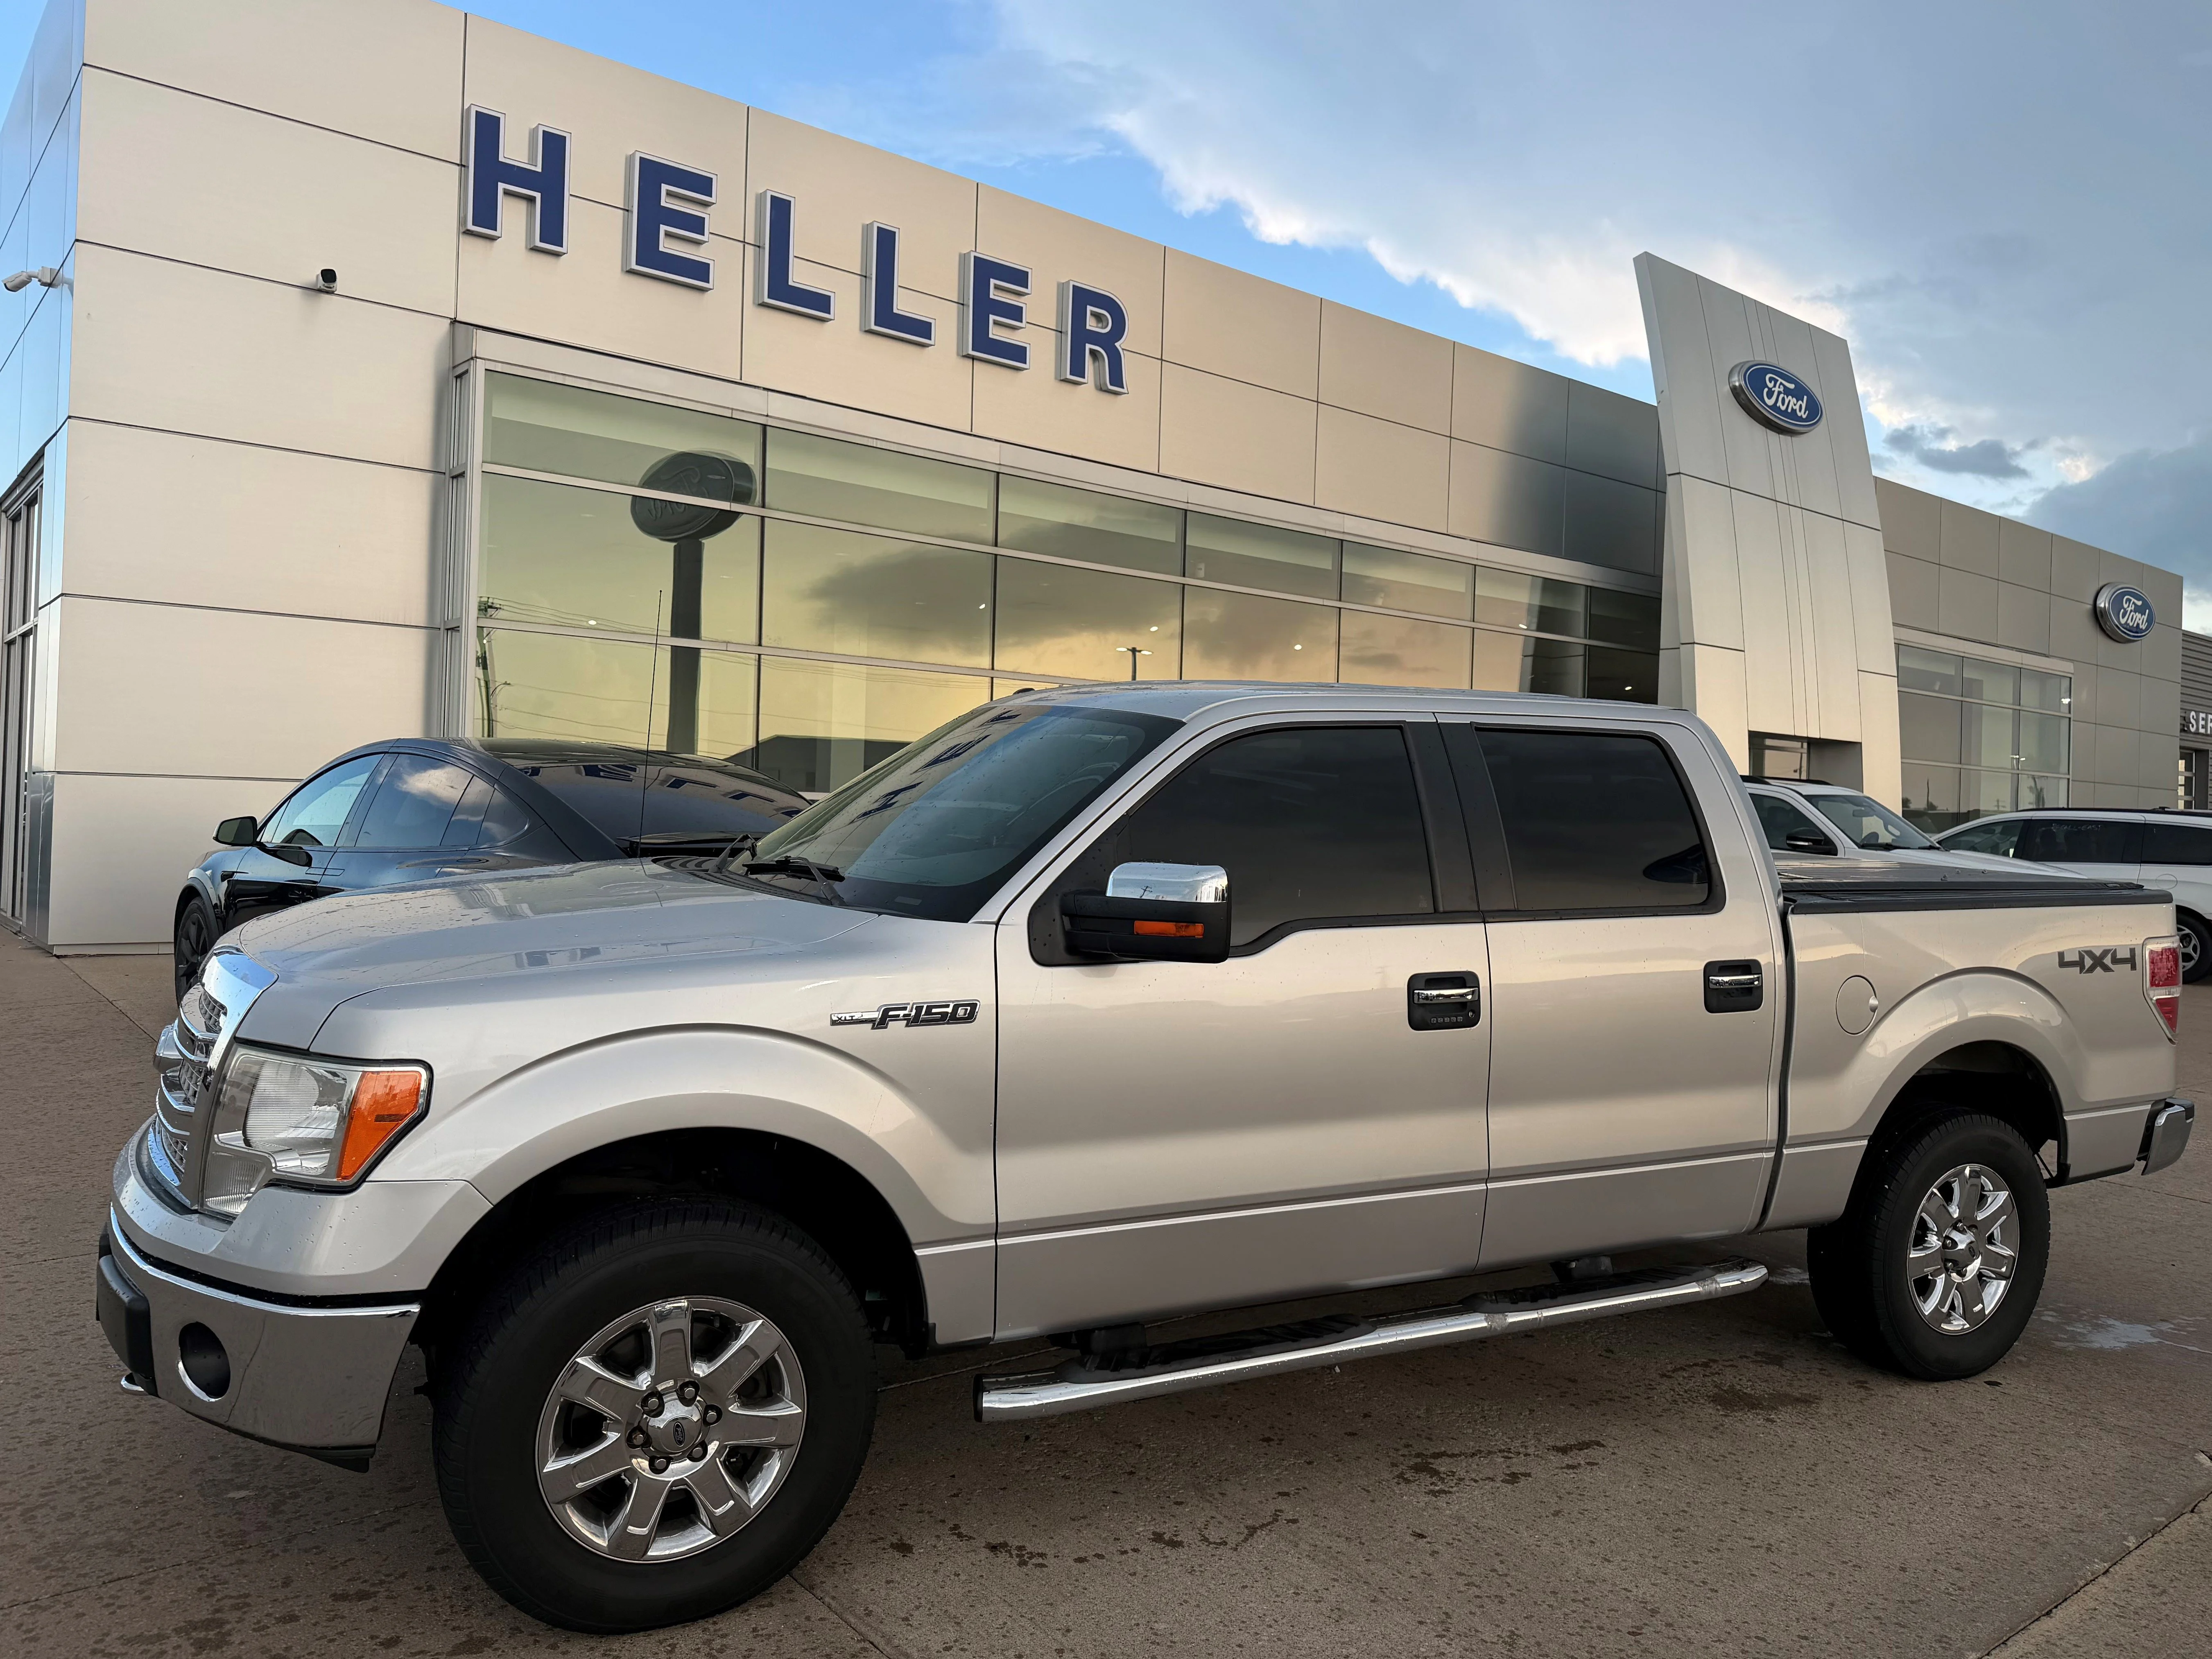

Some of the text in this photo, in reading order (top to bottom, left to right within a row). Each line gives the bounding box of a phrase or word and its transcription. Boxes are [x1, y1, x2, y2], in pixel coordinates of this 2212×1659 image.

[462, 103, 1129, 395] HELLER
[1763, 373, 1809, 419] Ford
[2119, 595, 2149, 631] Ford
[871, 999, 980, 1030] F-150
[675, 1427, 683, 1442] Ford
